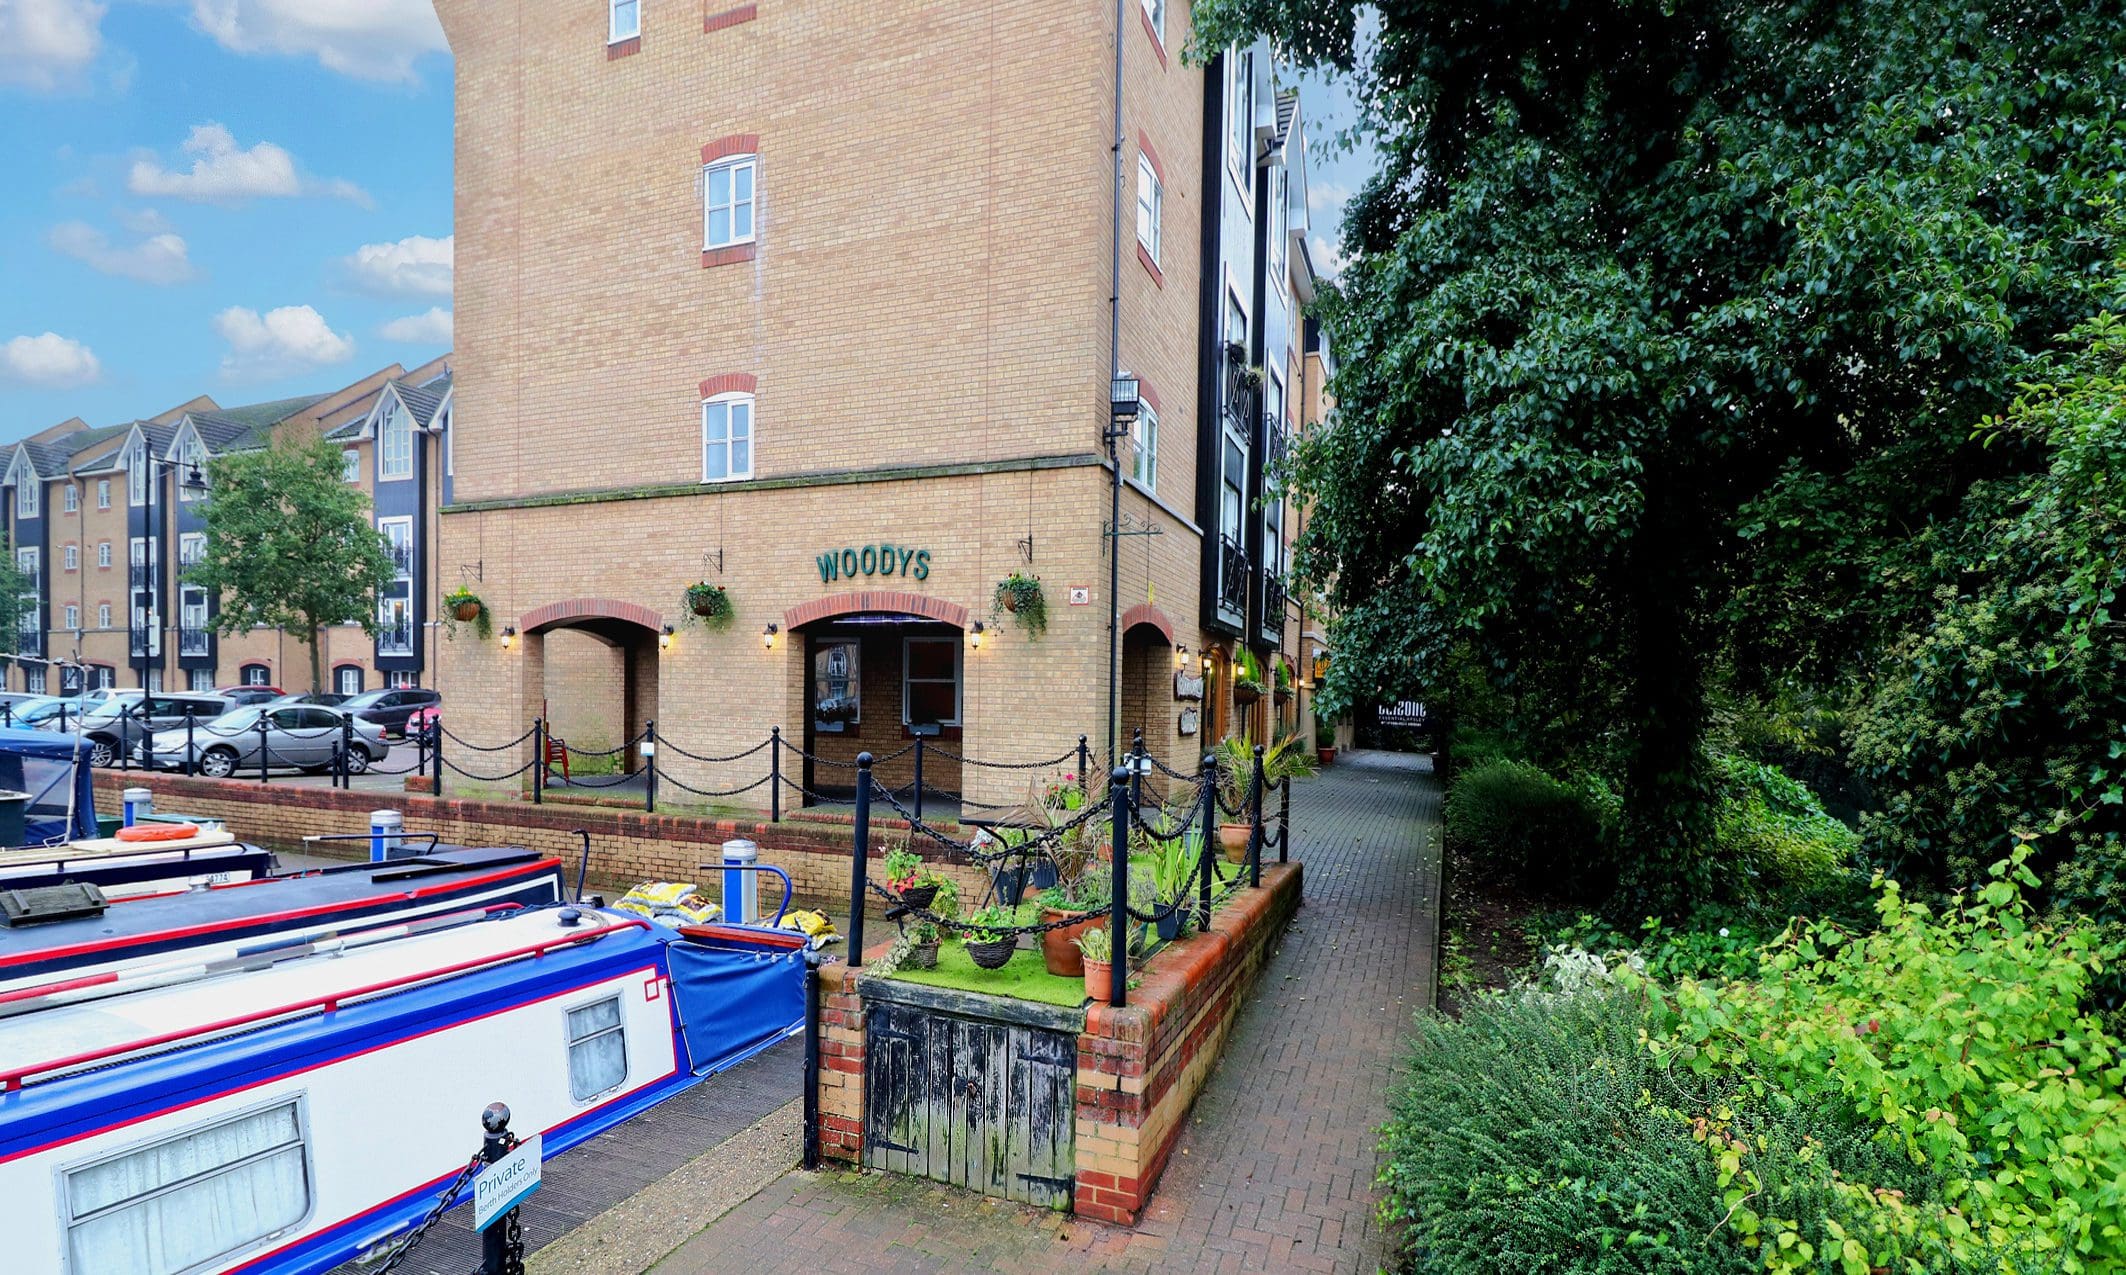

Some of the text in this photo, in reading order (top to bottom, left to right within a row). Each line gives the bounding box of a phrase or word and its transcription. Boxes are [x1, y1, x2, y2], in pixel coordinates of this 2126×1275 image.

[816, 543, 931, 583] WOODYS
[478, 1166, 538, 1215] Berth Holders Only
[479, 1158, 526, 1200] Private
